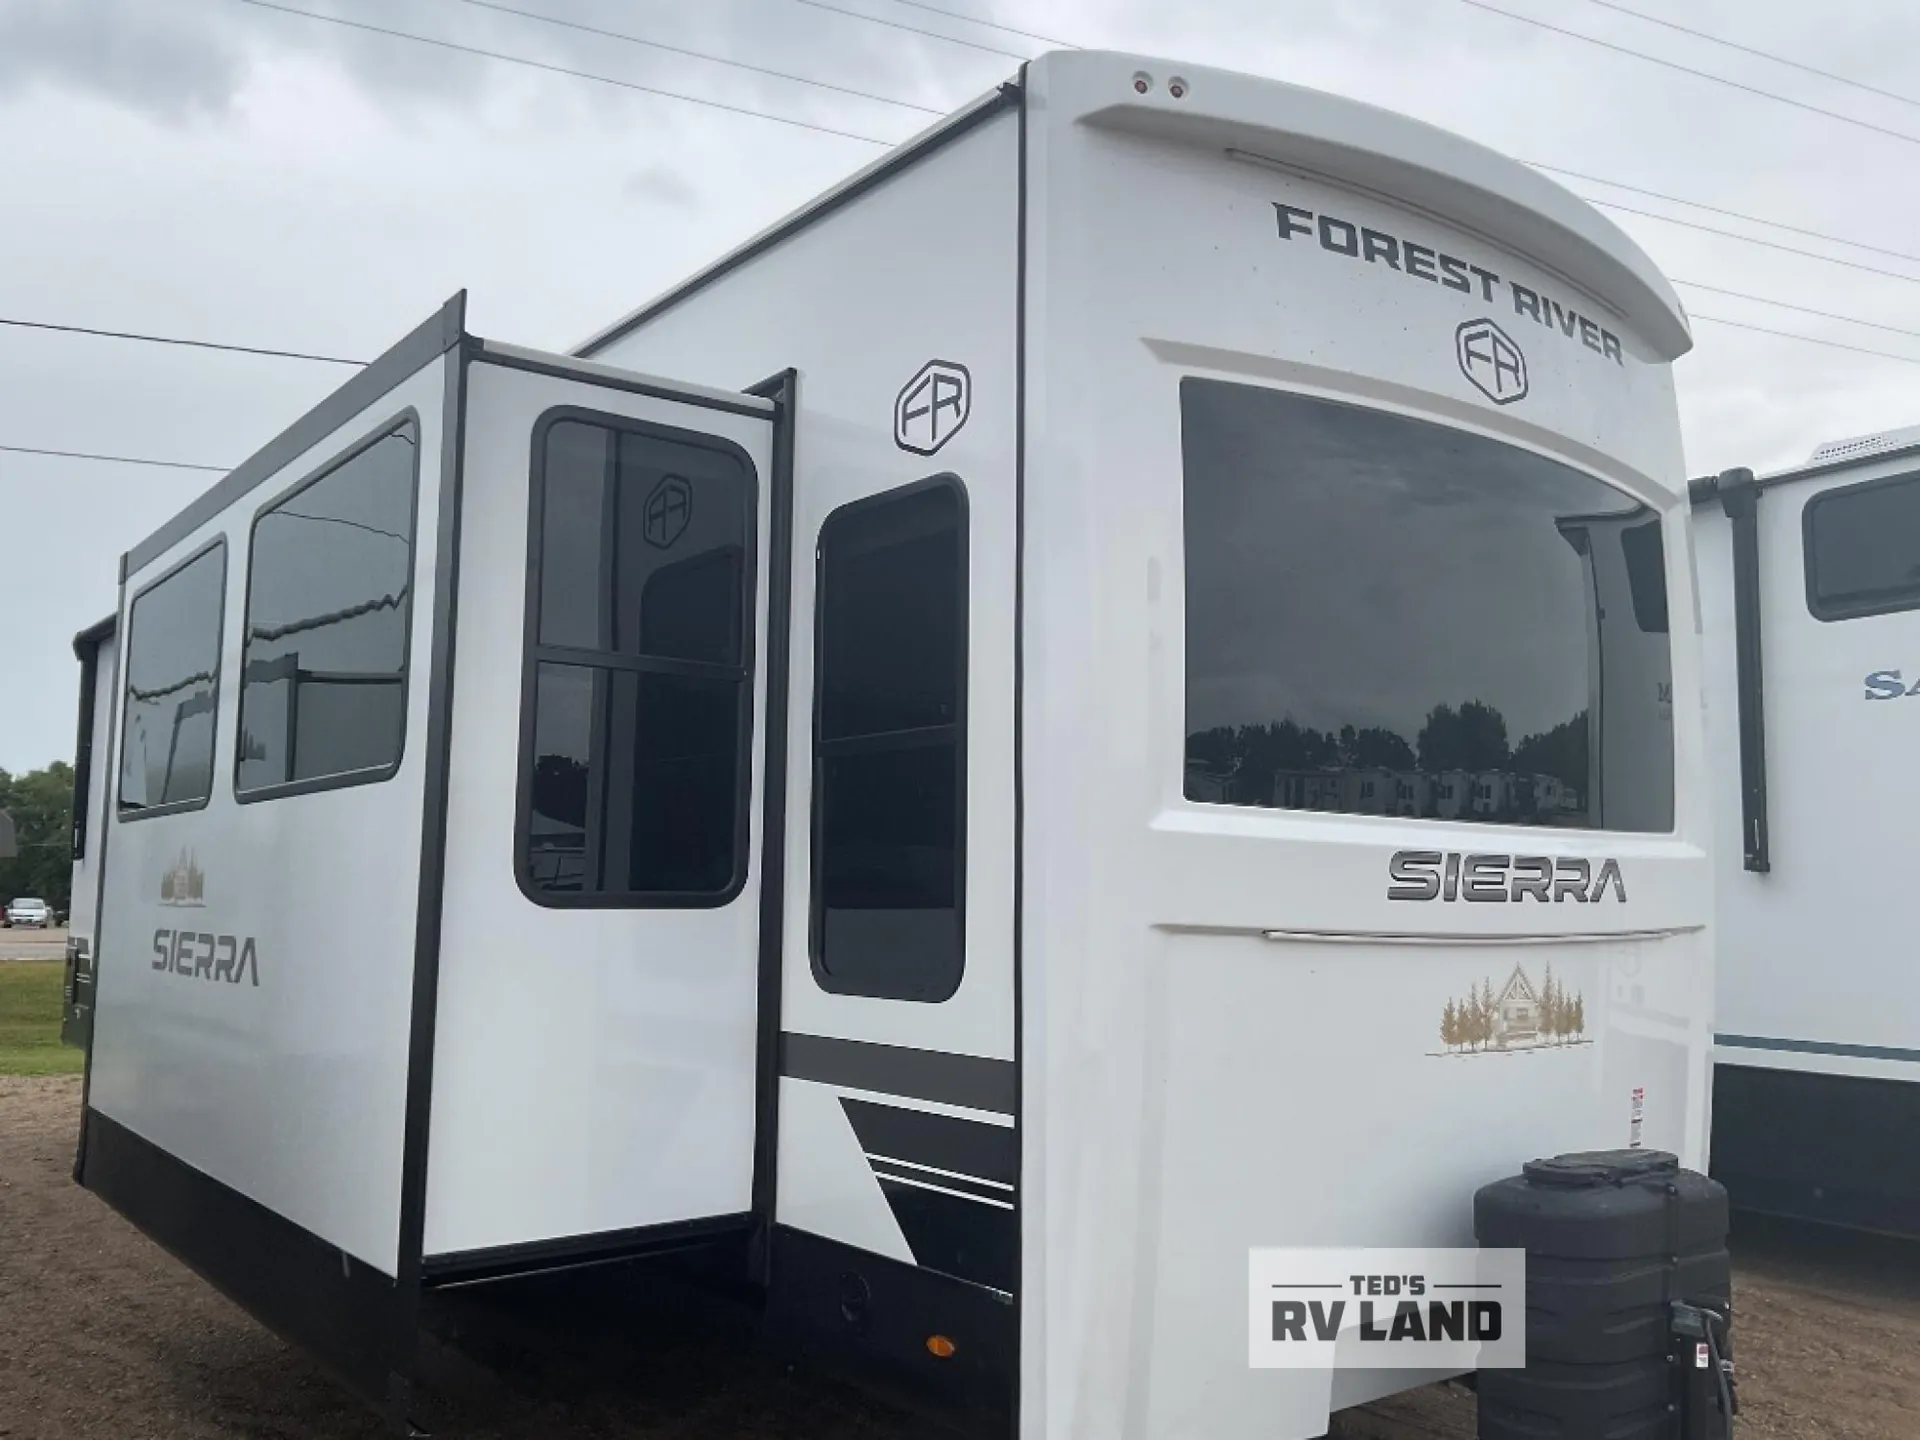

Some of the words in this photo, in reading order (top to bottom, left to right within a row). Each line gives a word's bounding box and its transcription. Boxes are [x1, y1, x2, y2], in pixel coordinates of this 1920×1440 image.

[1271, 201, 1500, 303] FOREST
[1508, 280, 1625, 368] RIVER
[1387, 850, 1627, 902] SIERRA
[151, 928, 260, 987] SIERRA
